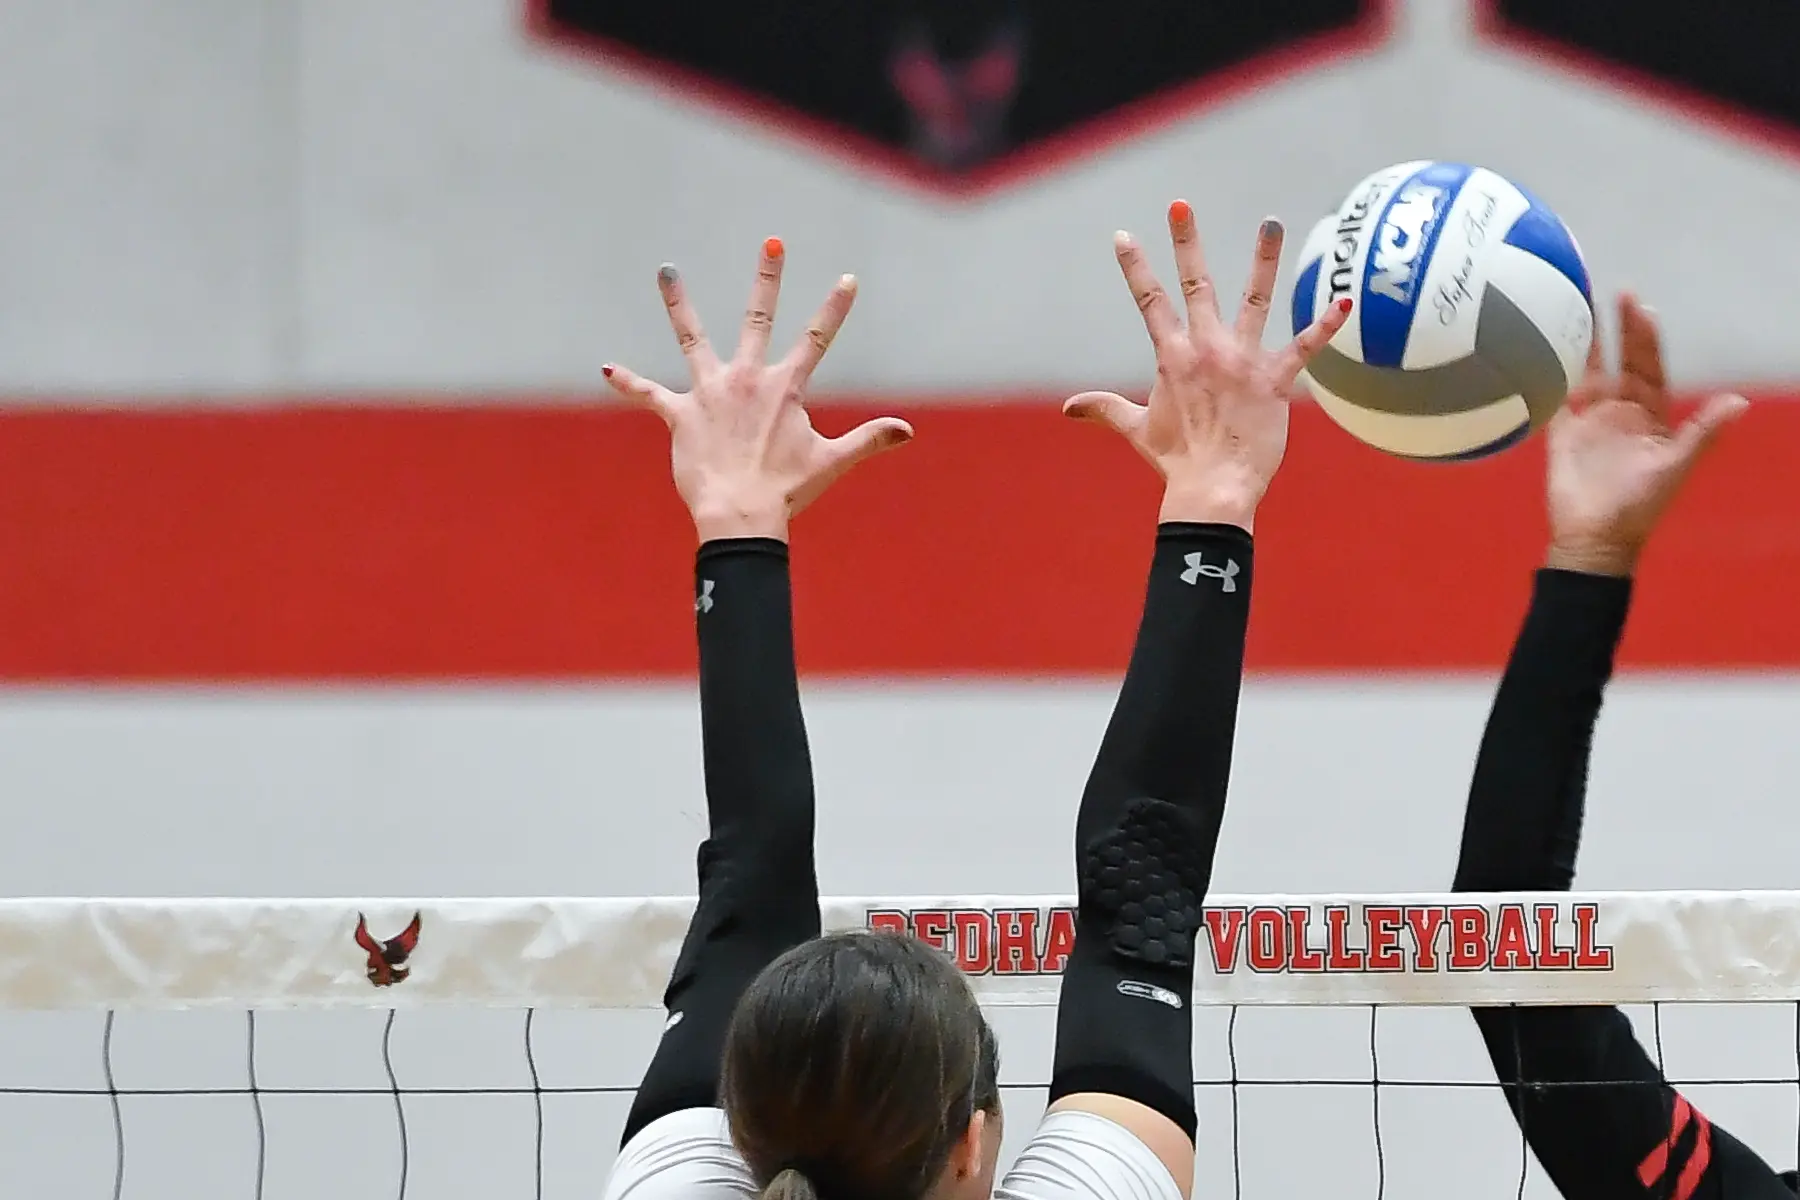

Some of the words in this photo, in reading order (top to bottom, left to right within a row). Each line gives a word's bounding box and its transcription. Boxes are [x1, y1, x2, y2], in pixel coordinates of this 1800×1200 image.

[1432, 254, 1473, 327] Super
[867, 907, 1078, 976] EDHA
[1199, 903, 1615, 975] VOLLEYBALL
